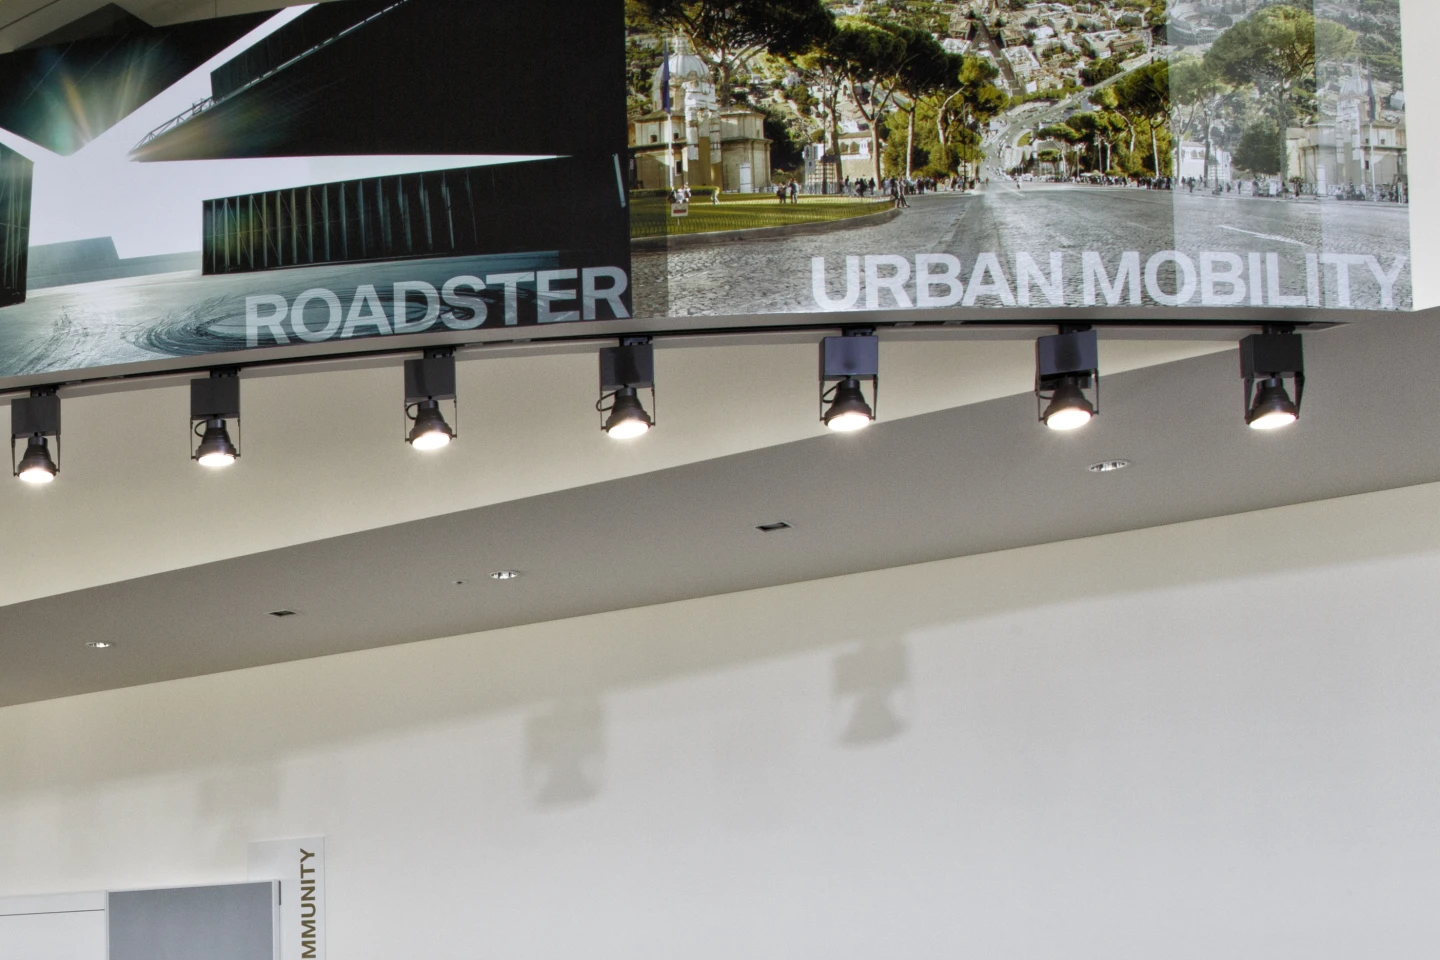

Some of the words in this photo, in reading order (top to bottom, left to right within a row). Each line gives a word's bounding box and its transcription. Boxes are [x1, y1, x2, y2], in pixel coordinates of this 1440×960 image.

[245, 266, 632, 347] ROADSTER
[811, 252, 1064, 309] URBAN
[1081, 251, 1409, 309] MOBILITY
